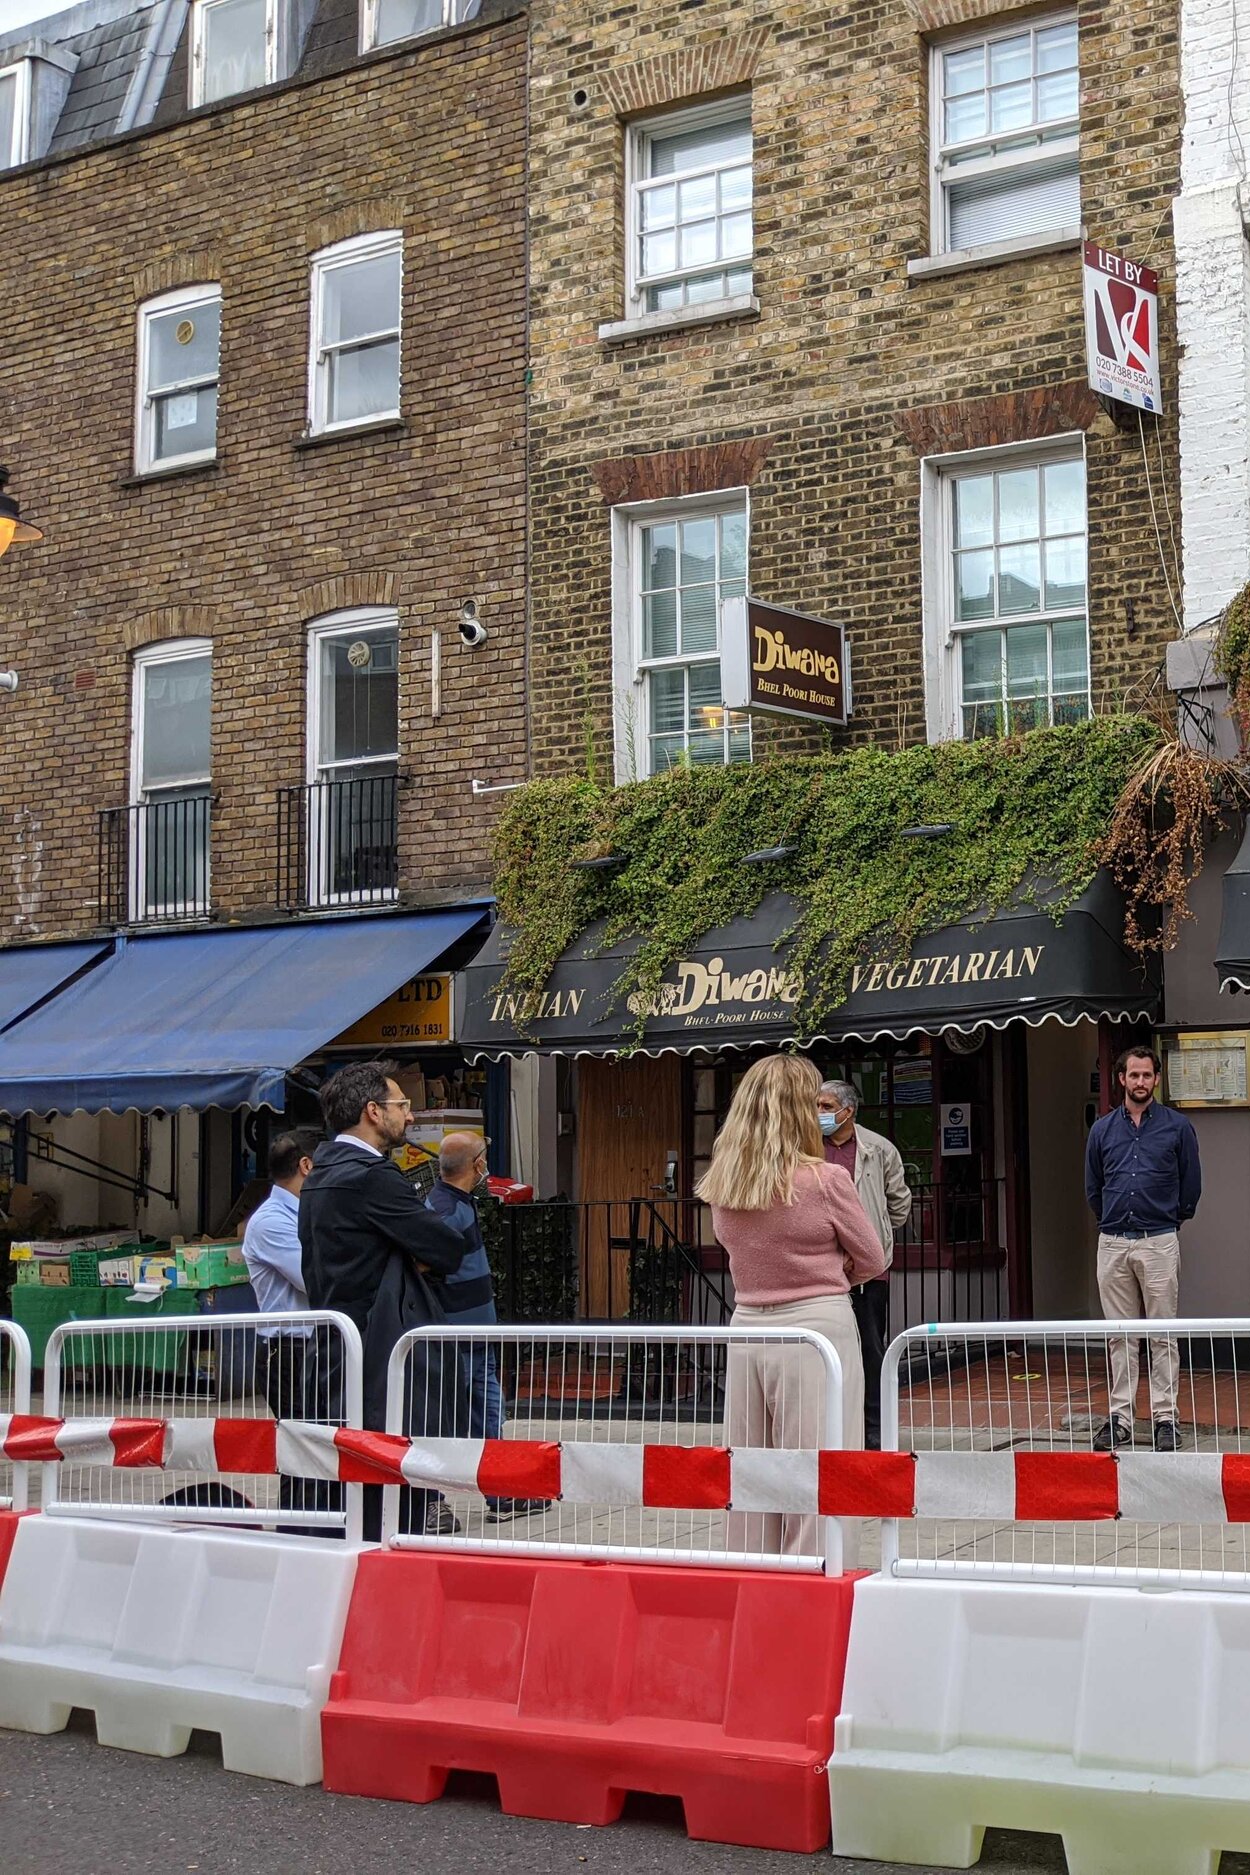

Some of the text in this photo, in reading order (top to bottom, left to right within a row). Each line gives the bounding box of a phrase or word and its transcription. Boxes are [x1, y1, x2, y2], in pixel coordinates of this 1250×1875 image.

[1098, 249, 1143, 285] LET BY
[1095, 356, 1154, 387] 020 7388 5504
[757, 678, 836, 707] BHEL POORI HOUSE
[850, 945, 1046, 994] VEGETARIAN
[397, 978, 442, 1002] LTD
[381, 1023, 443, 1037] 020 7916 1831
[750, 1009, 786, 1022] HOUSE
